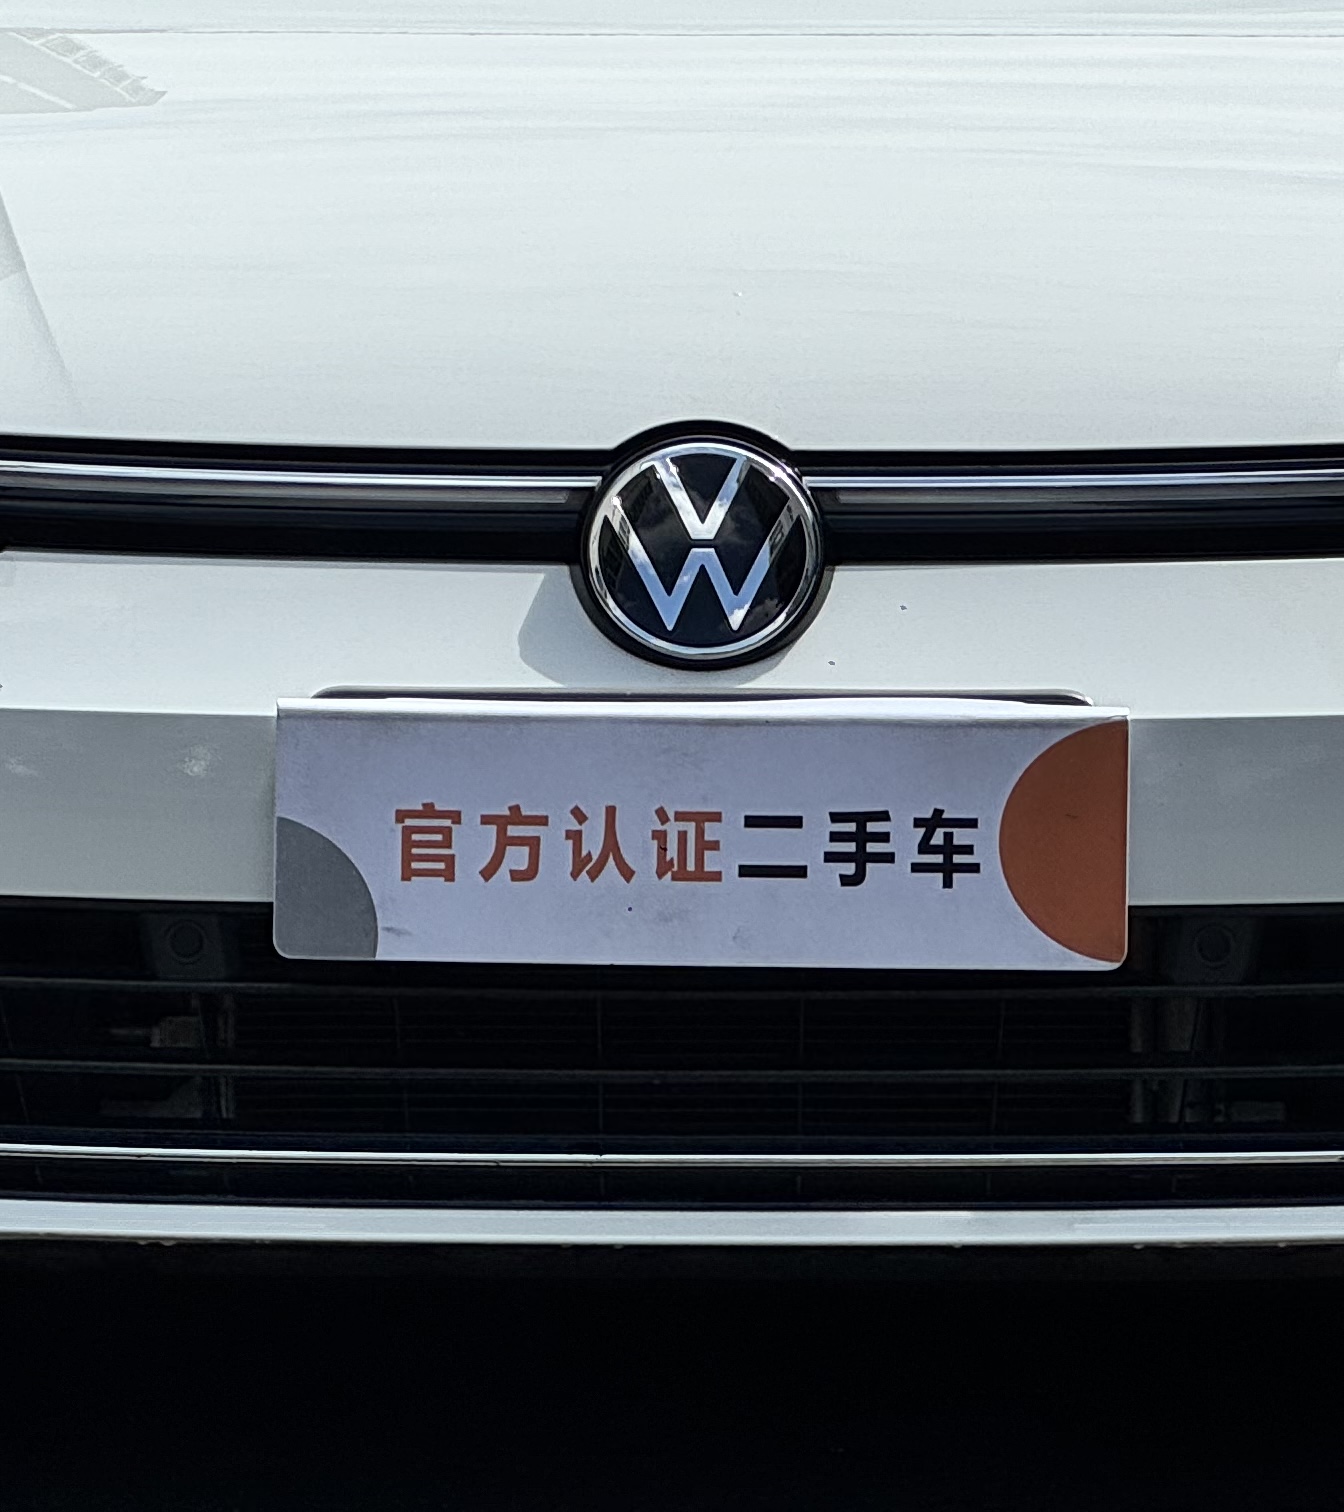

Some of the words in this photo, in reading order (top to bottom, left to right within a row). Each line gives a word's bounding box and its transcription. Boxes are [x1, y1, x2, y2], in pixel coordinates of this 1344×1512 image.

[394, 801, 982, 890] 官方认证二手车
